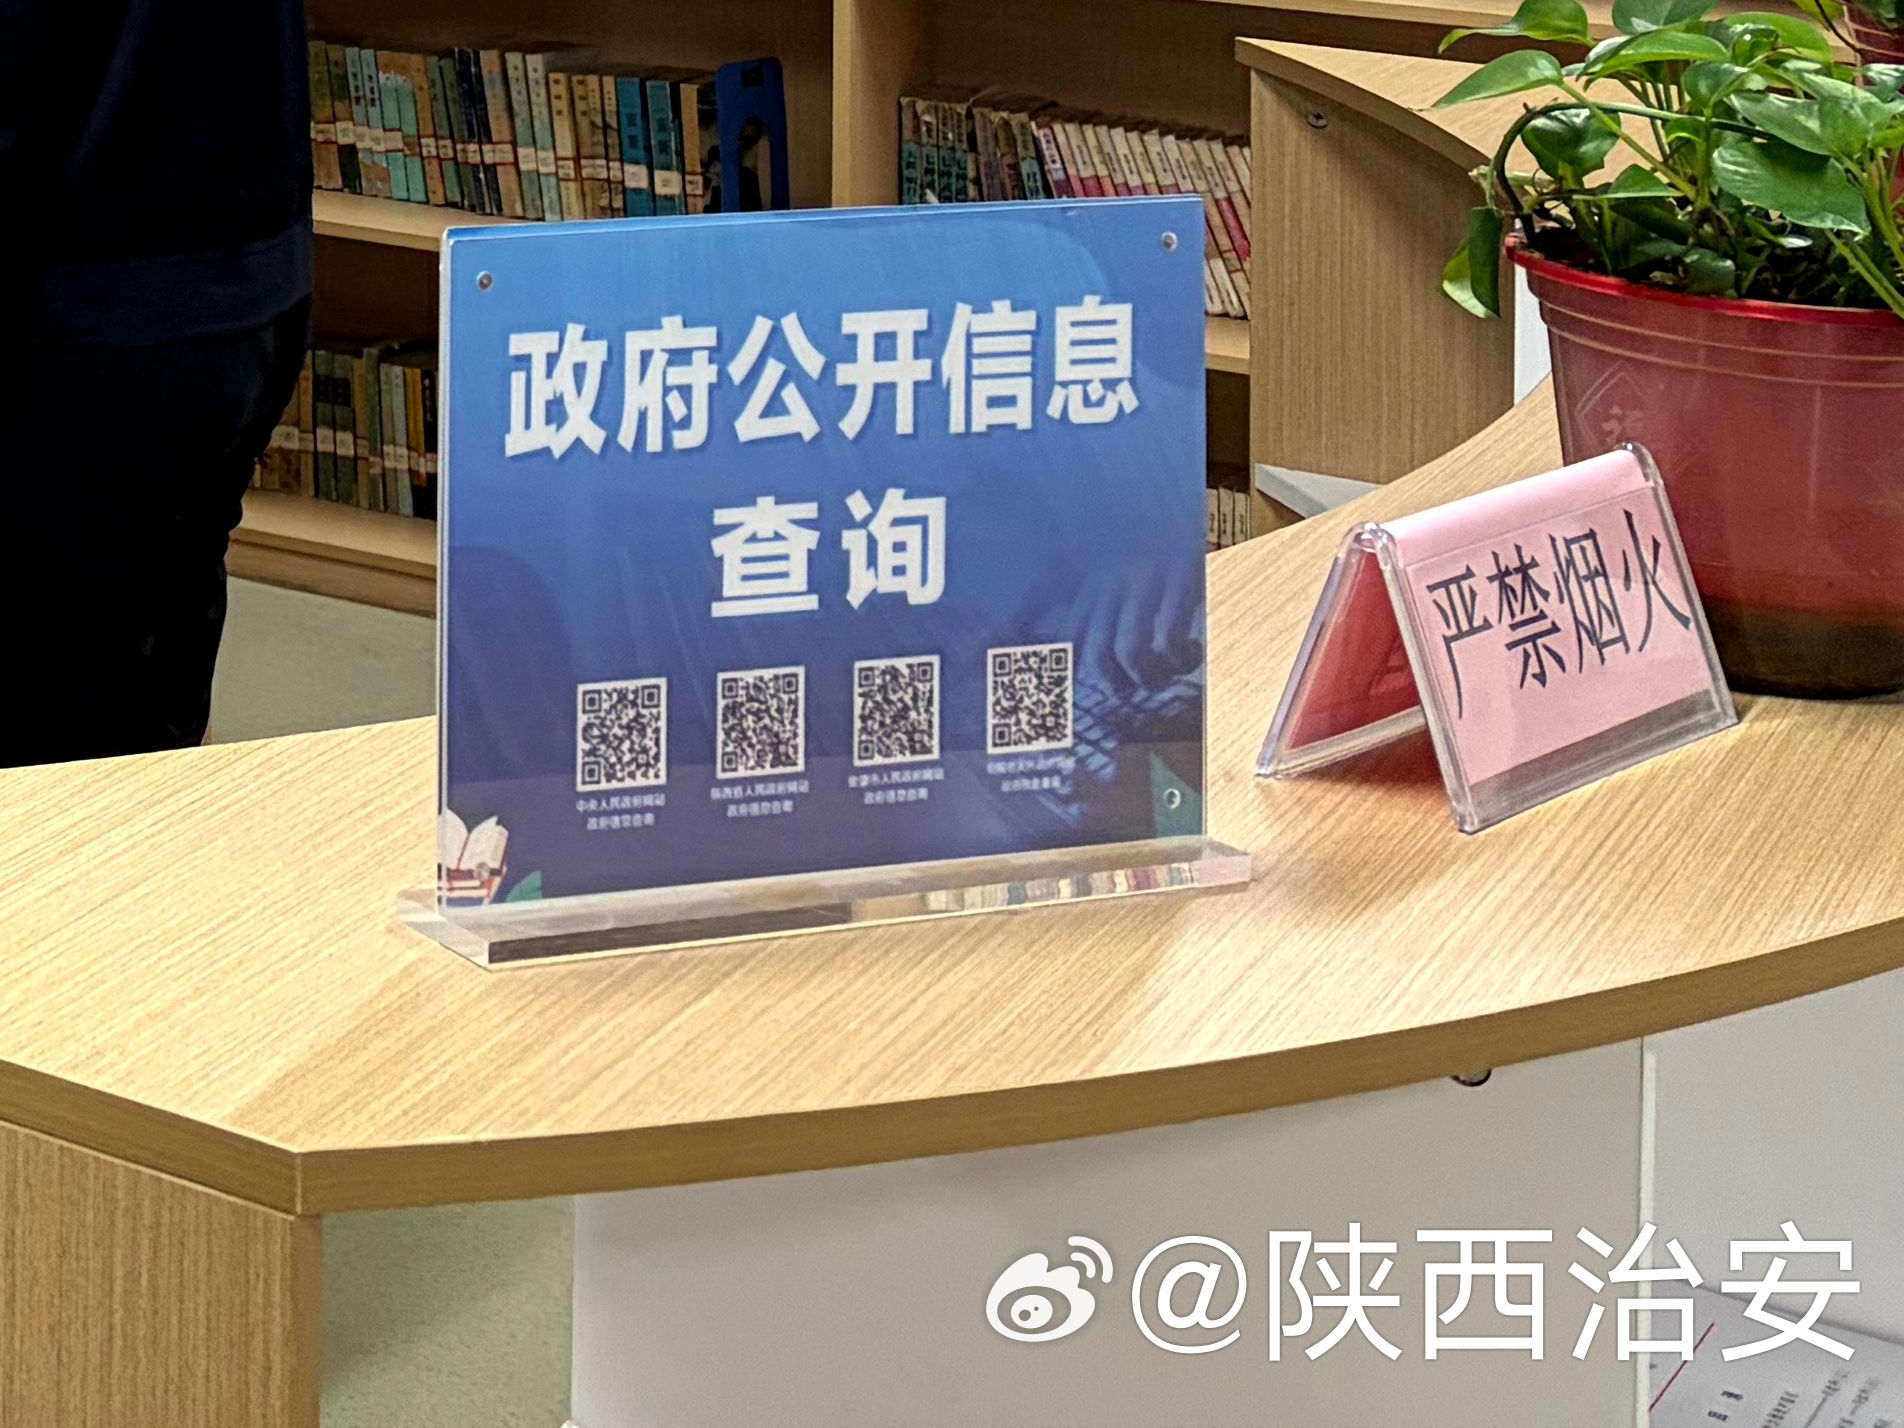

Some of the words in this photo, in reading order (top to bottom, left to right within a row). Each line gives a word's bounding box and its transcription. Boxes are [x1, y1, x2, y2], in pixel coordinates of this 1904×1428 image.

[503, 294, 1140, 459] 政府公开信息
[709, 486, 949, 619] 查询
[1425, 509, 1692, 721] 严禁烟火
